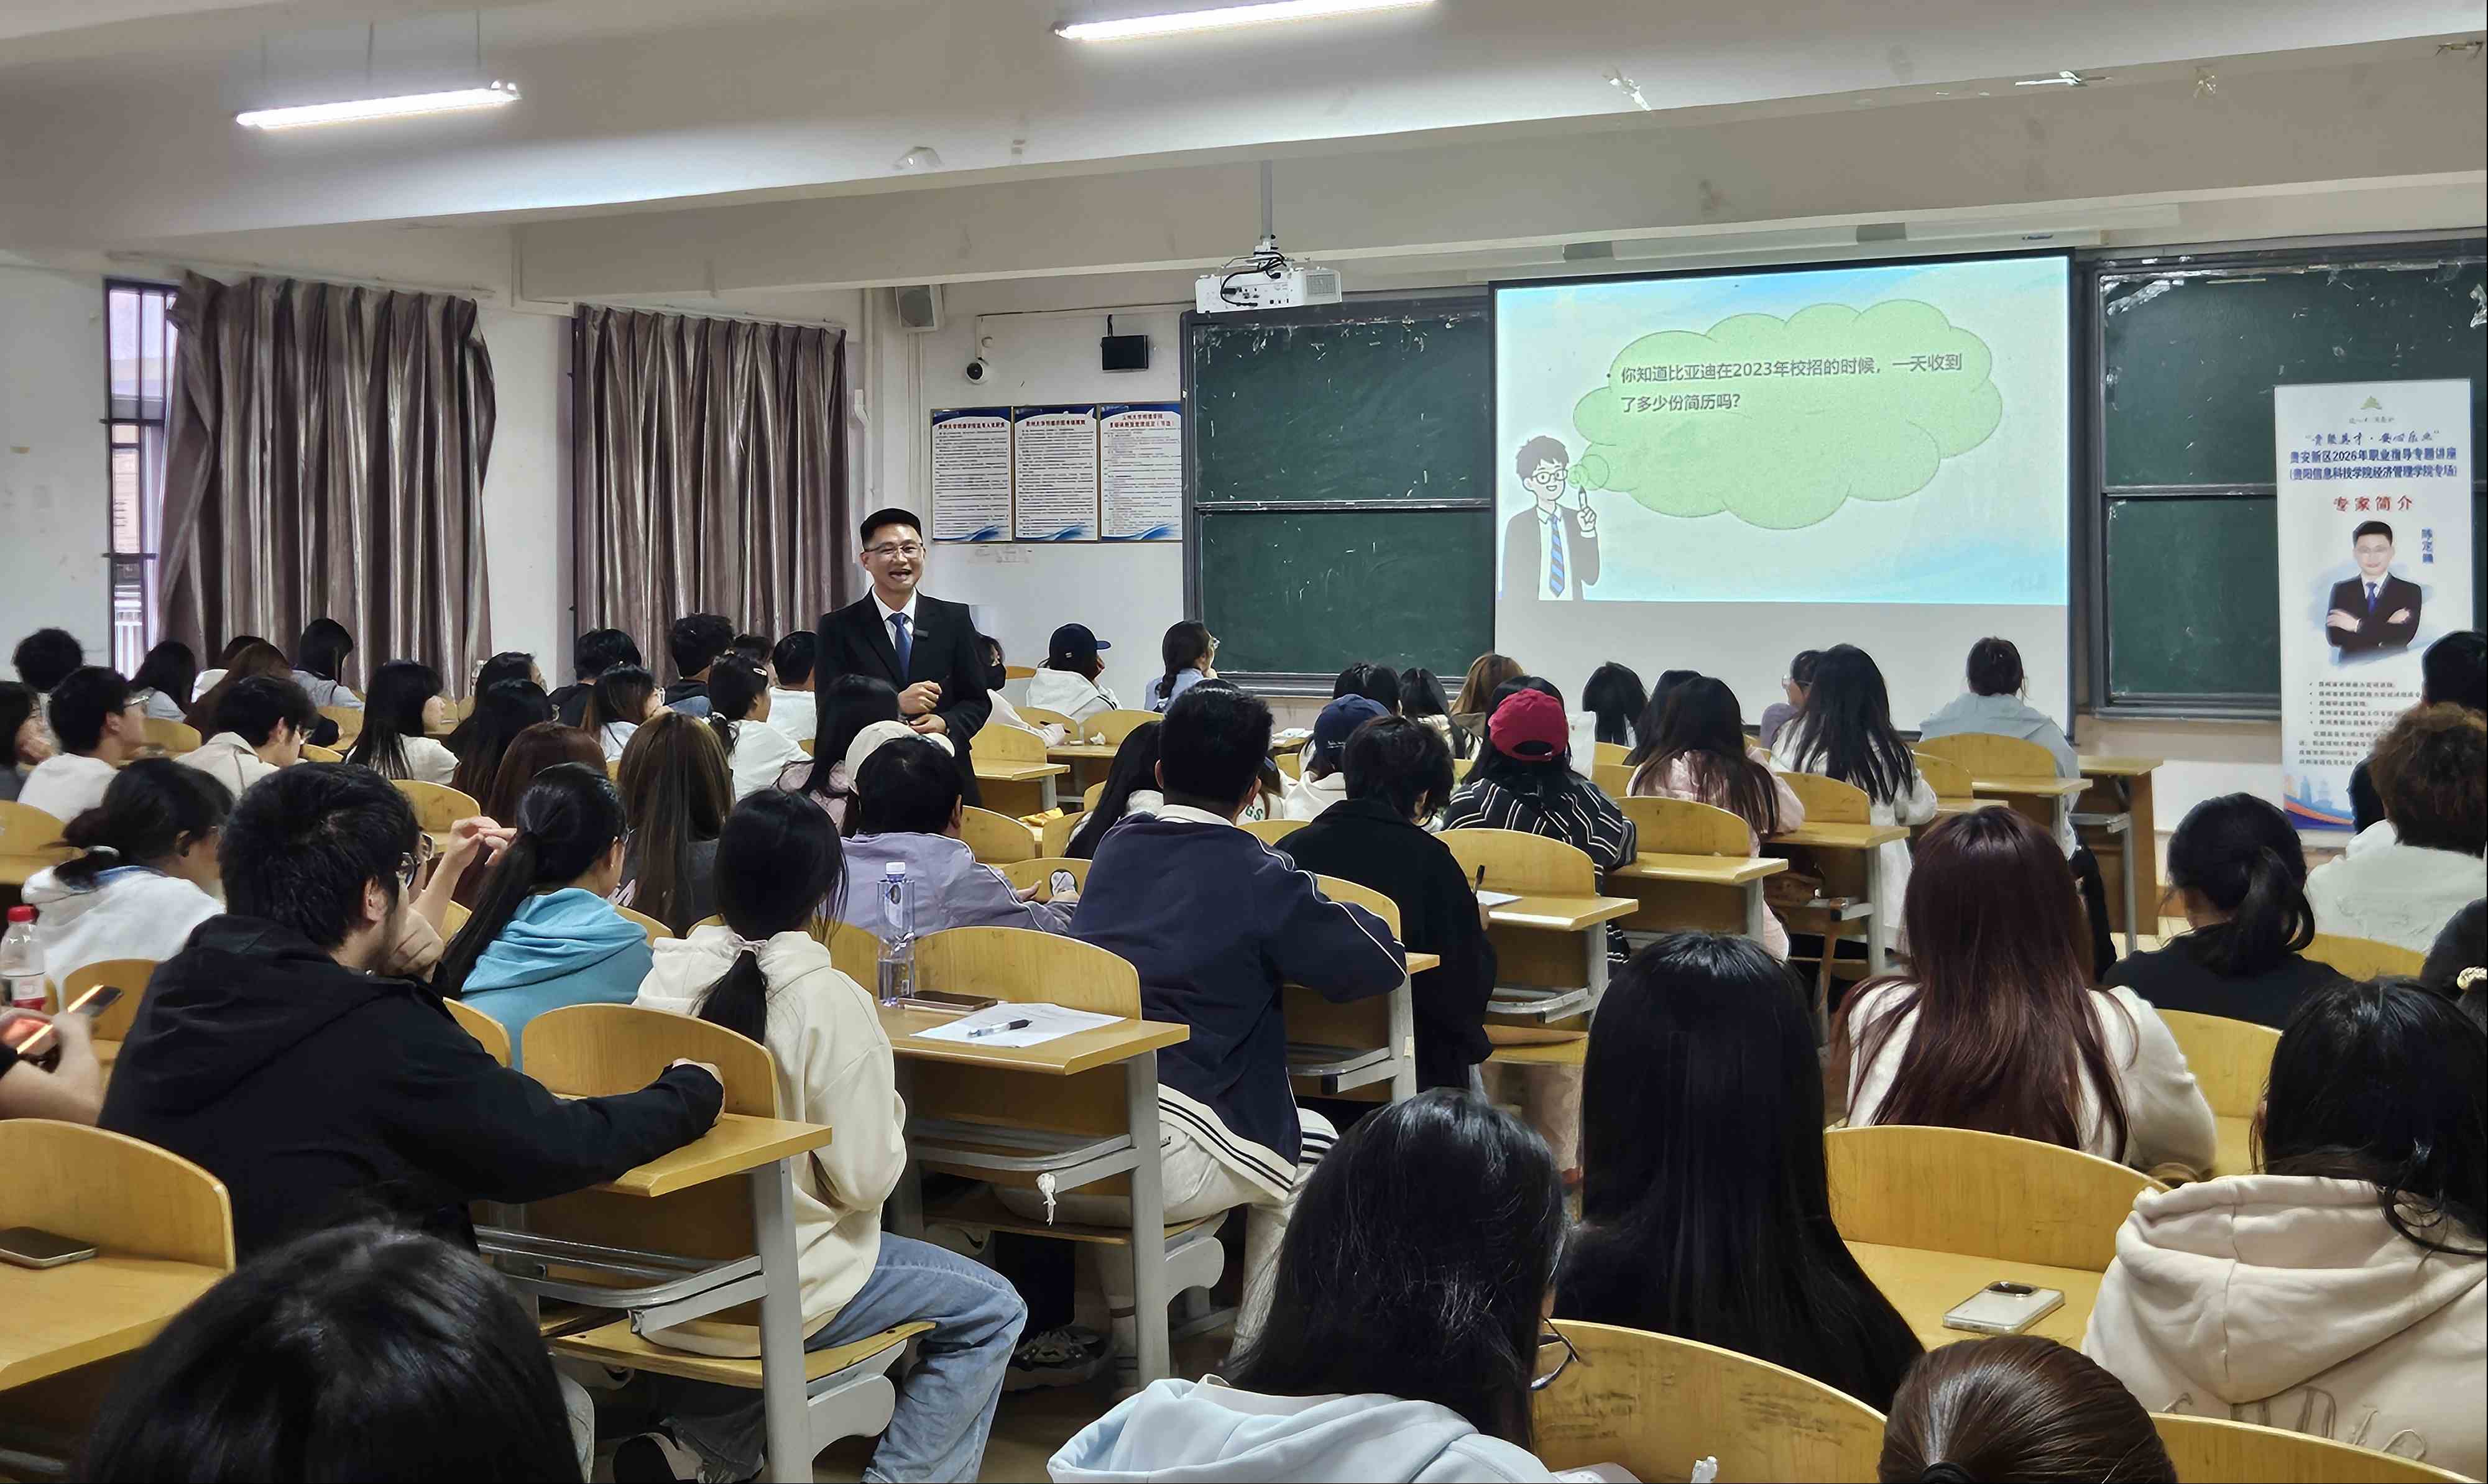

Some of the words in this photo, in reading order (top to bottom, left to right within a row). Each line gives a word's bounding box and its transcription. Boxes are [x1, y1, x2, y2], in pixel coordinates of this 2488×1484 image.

[1621, 353, 1962, 384] 你知道比亚迪在2023年校招的时候，一天收到
[2290, 447, 2457, 463] 贵安新区2026年职业指导专题讲座
[2333, 495, 2413, 512] 专家简介
